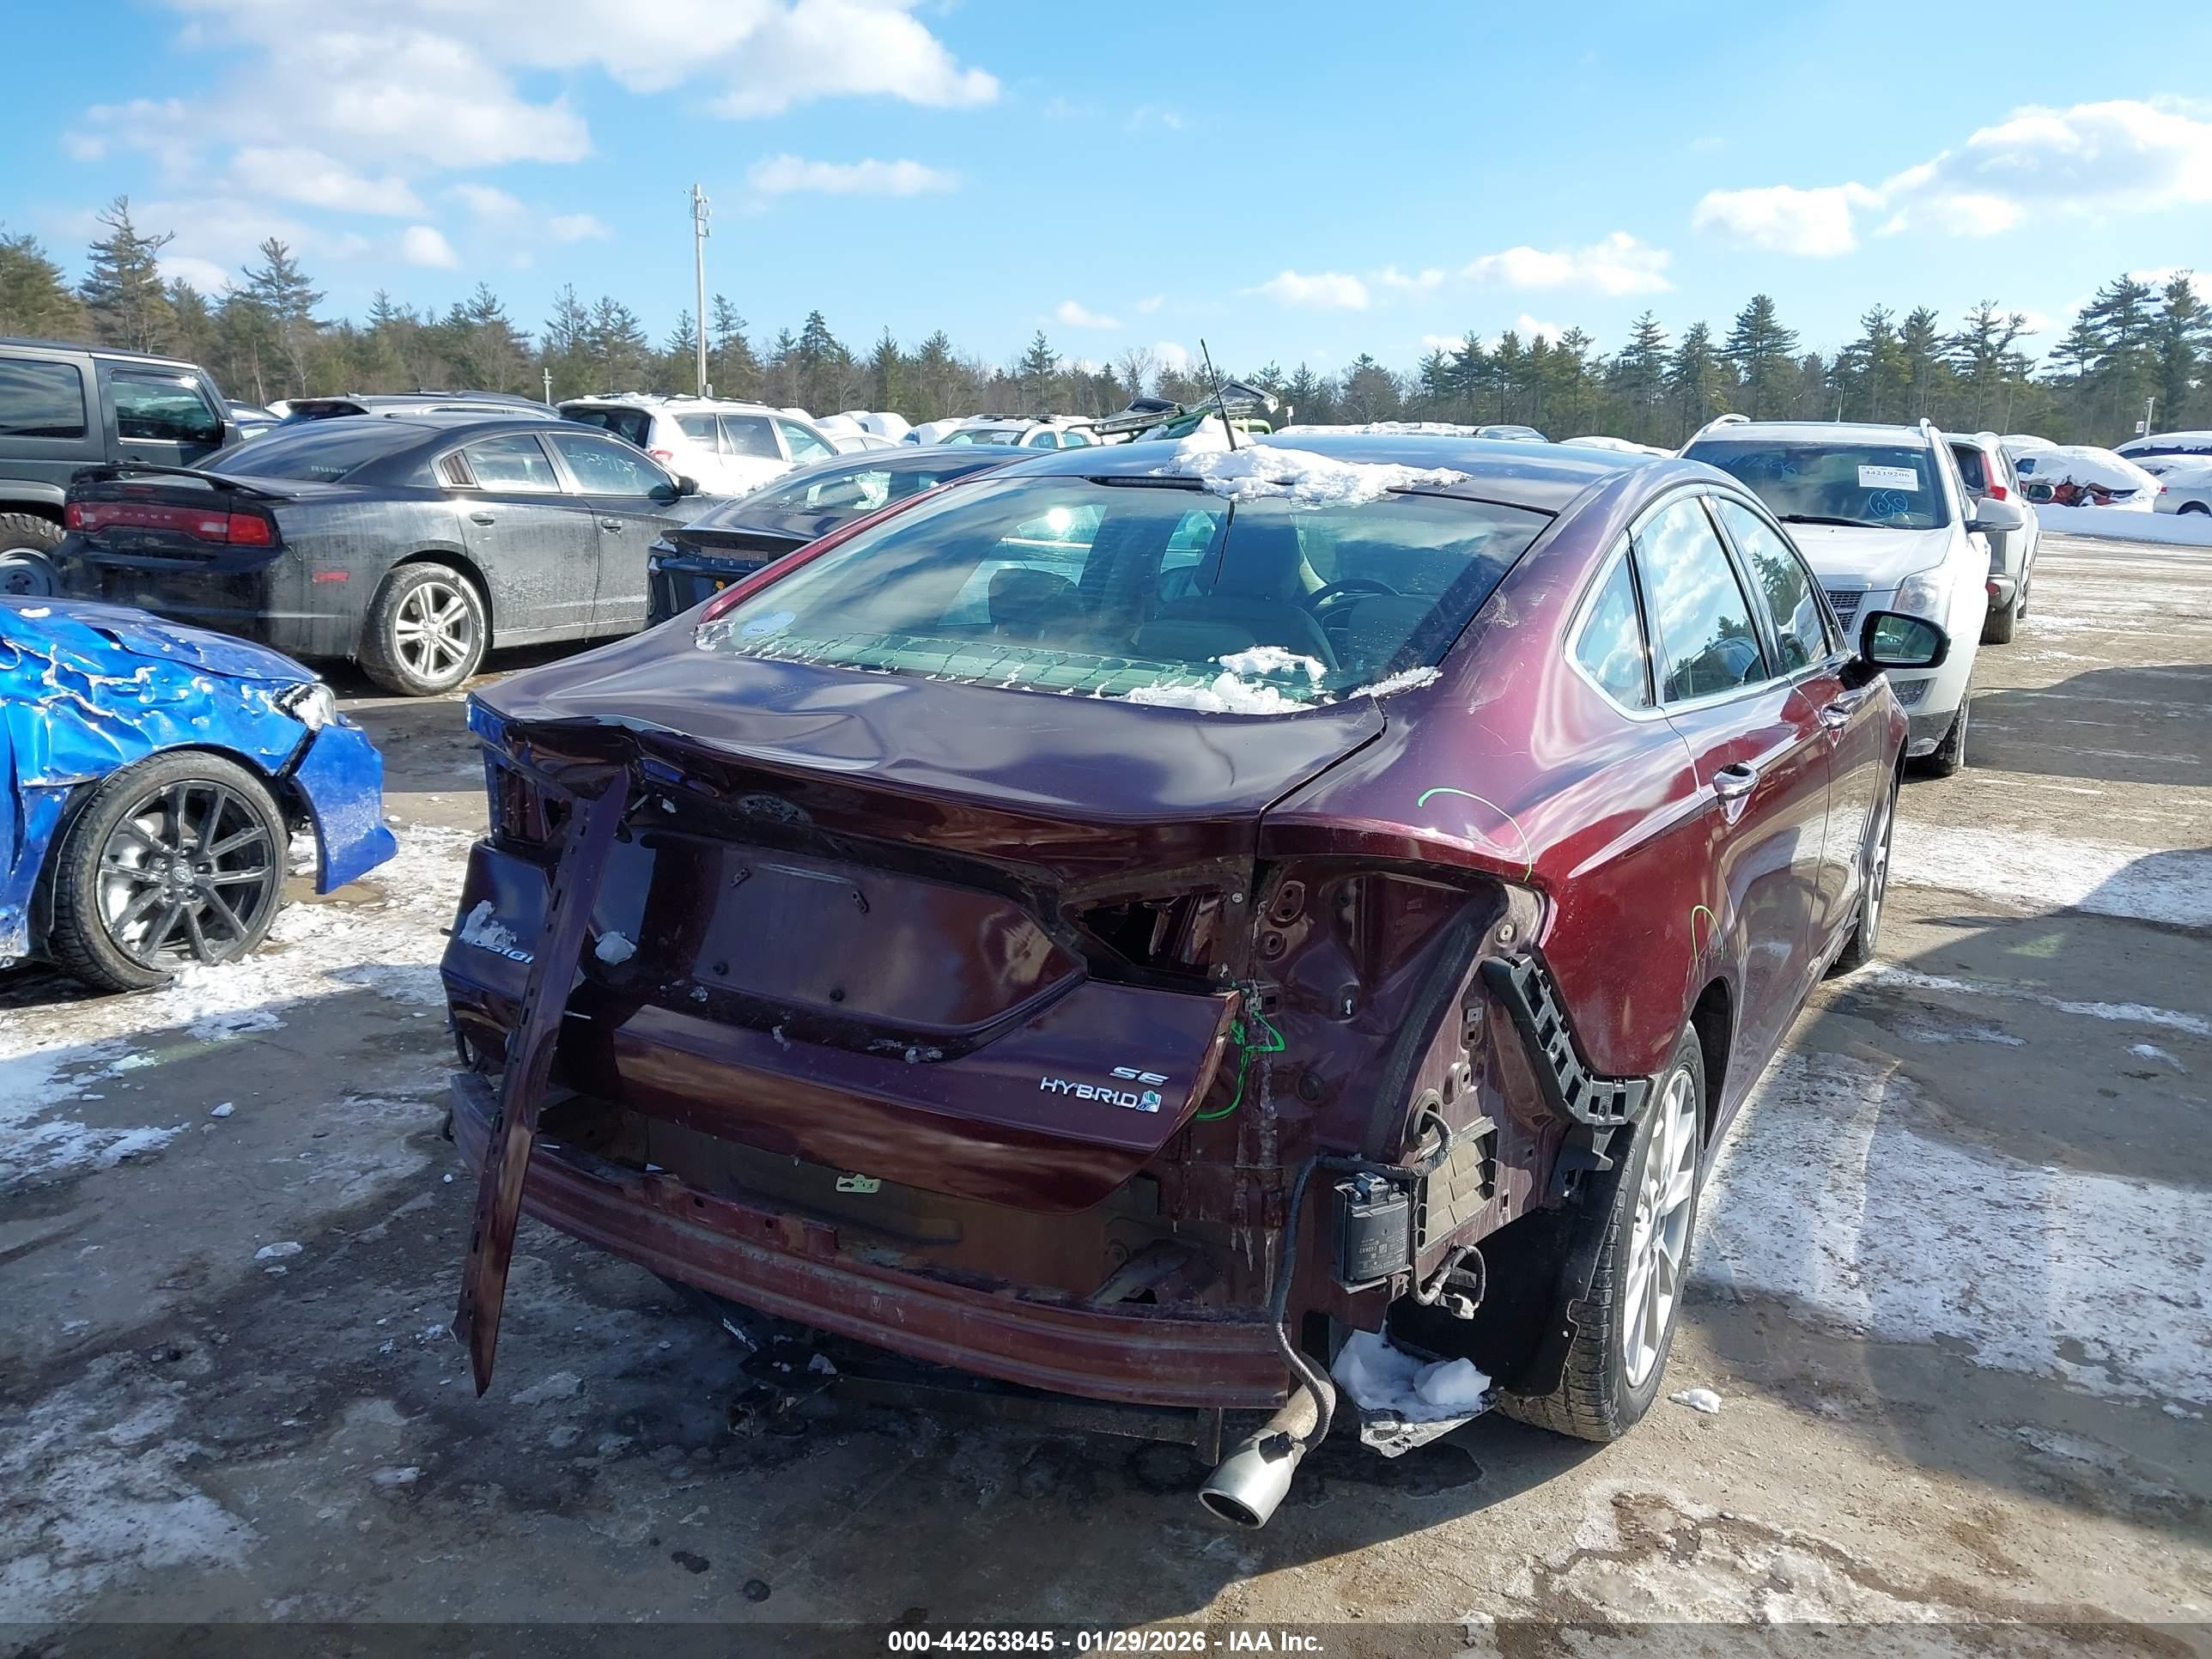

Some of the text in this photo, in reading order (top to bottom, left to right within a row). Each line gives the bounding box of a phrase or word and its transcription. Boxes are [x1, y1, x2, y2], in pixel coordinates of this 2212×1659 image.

[112, 511, 173, 520] DODGE
[1109, 1066, 1170, 1086] SE
[1040, 1076, 1137, 1109] HYBRID
